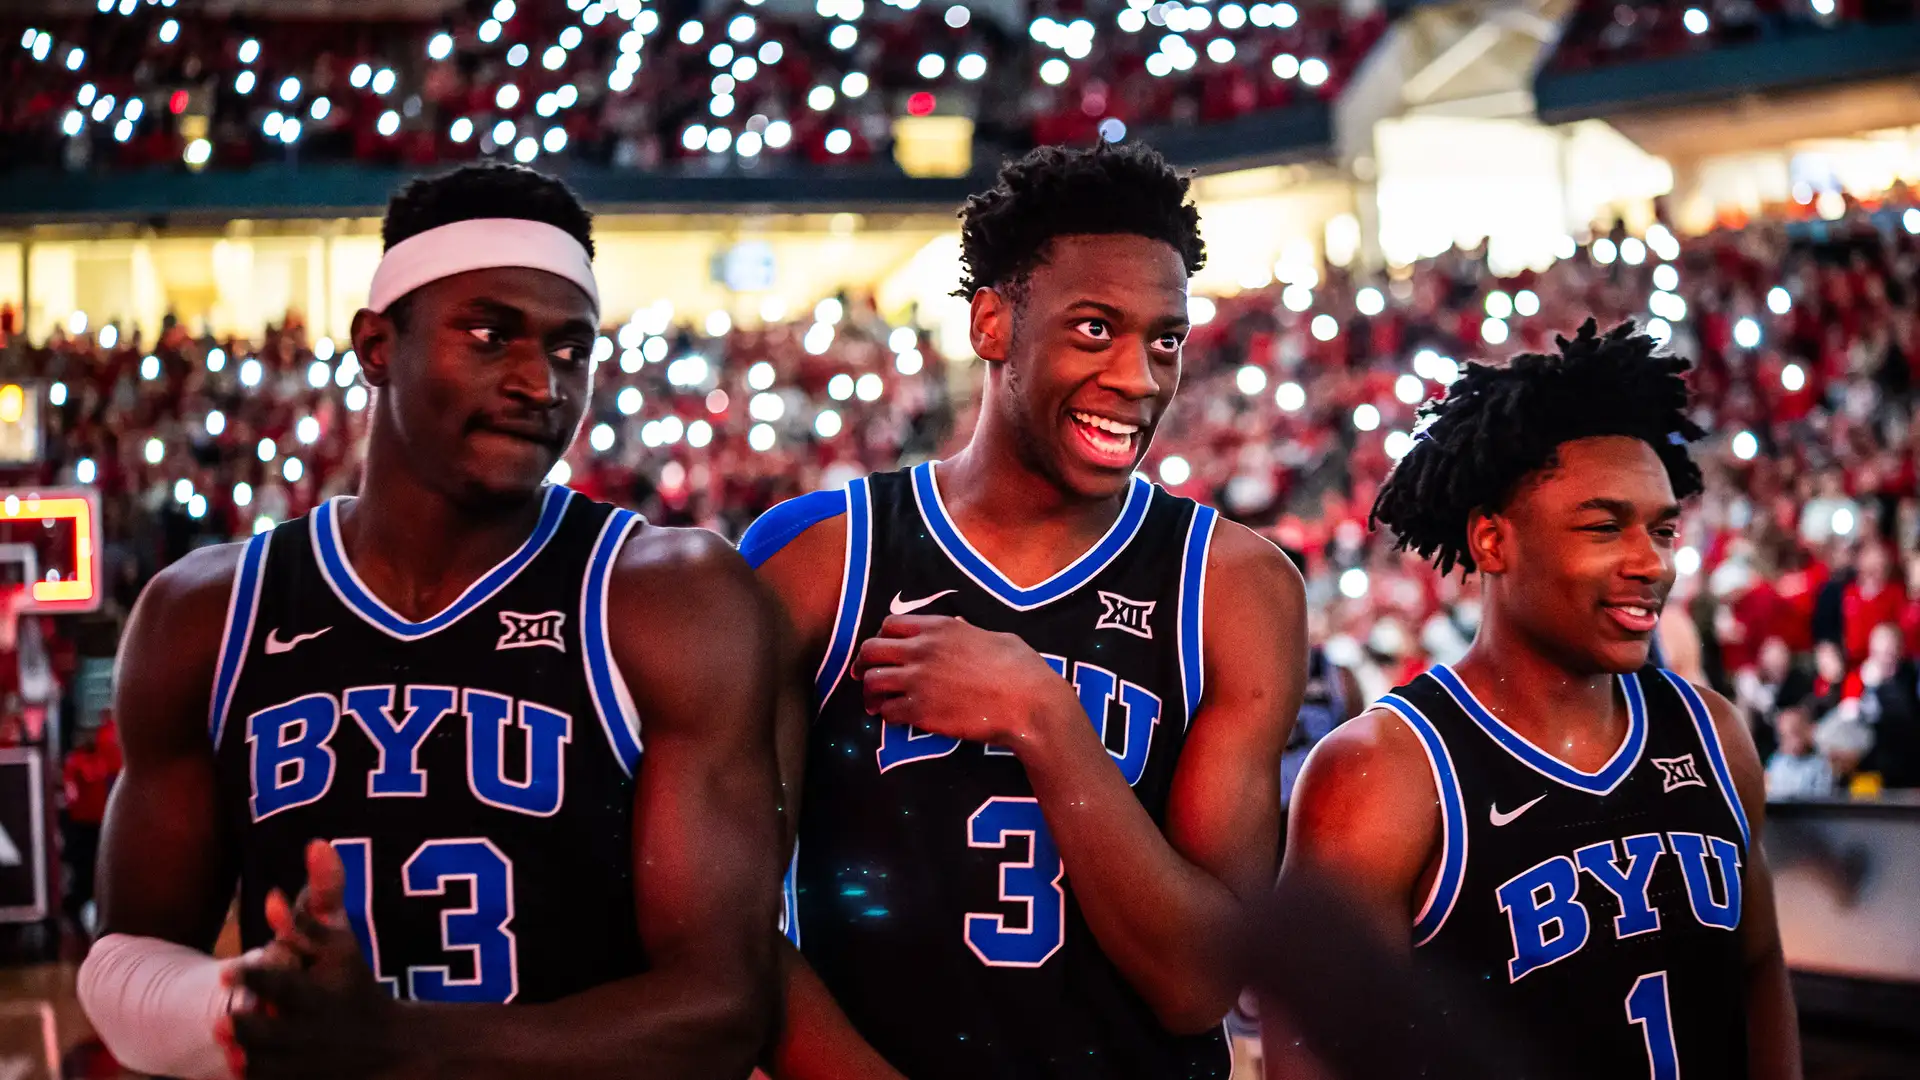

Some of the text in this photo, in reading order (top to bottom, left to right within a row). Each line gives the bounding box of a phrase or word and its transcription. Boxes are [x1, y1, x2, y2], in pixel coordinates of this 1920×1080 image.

[245, 684, 572, 823] BYU
[964, 796, 1065, 968] 3
[1495, 831, 1742, 984] BYU
[1625, 970, 1681, 1080] 1
